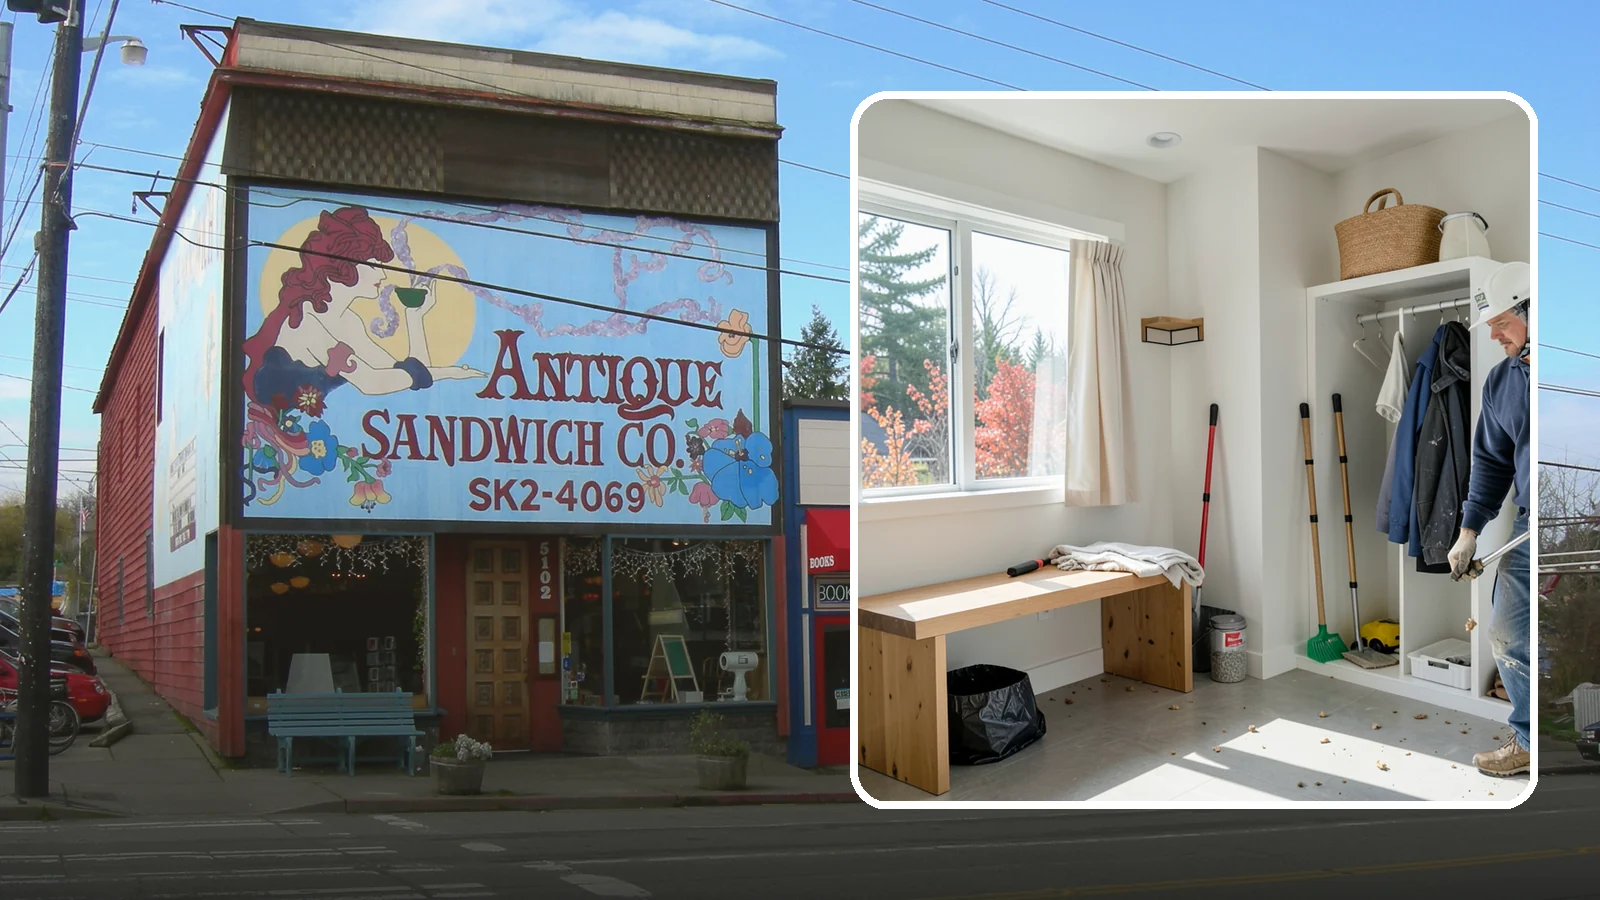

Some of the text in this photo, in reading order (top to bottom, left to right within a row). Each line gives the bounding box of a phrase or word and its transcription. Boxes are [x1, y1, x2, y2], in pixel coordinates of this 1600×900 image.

[475, 329, 724, 421] ANTIQUE
[361, 409, 686, 469] SANDWICH CO.
[469, 477, 646, 513] SK2-4069
[539, 541, 552, 600] 5102
[809, 555, 834, 568] BOOKS
